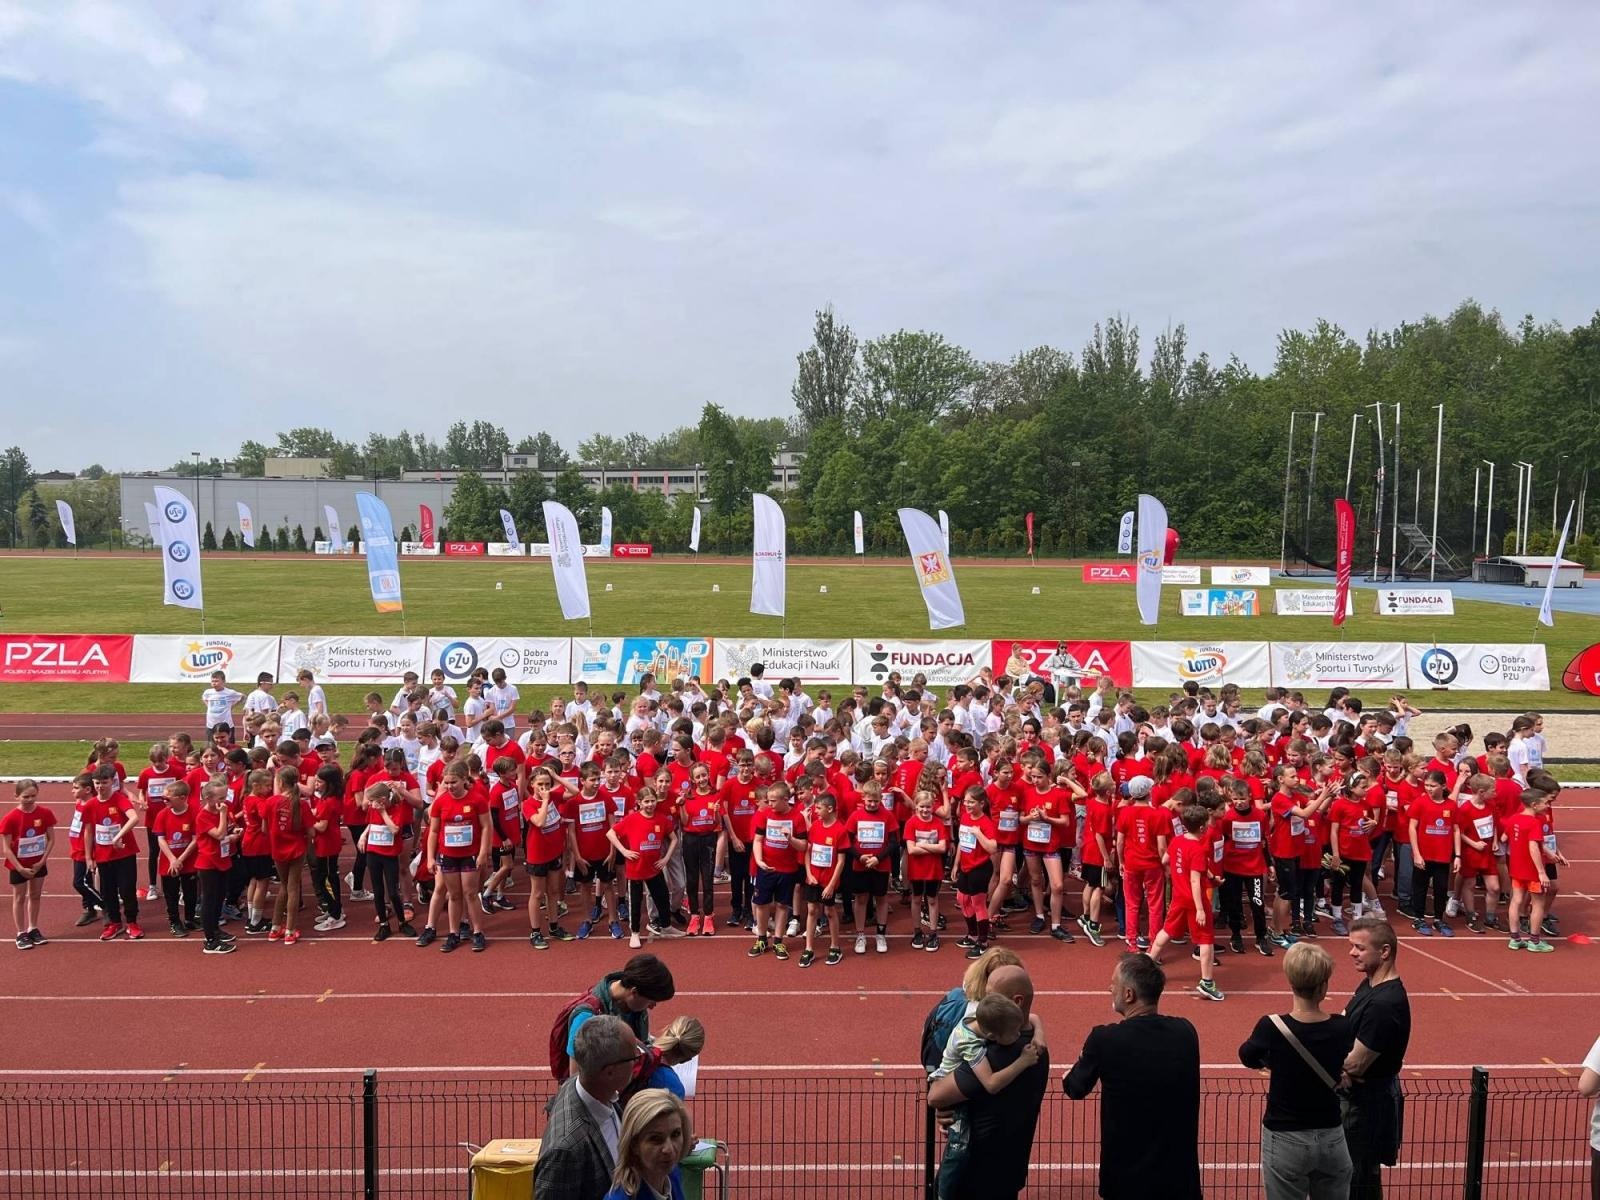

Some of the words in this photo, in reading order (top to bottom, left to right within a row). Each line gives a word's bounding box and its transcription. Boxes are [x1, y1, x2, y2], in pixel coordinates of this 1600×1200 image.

[1091, 568, 1130, 577] PZLA
[5, 642, 110, 666] PZLA
[329, 647, 392, 656] Ministerstwo
[524, 649, 549, 657] Dobra
[763, 647, 828, 657] Ministerstwo
[1316, 652, 1374, 661] Ministerstwo
[192, 652, 223, 667] LOTTO
[328, 658, 360, 669] Sportu
[363, 659, 366, 668] i
[368, 658, 411, 669] Turystyki
[448, 653, 470, 669] PZU
[891, 652, 975, 666] FUNDACJA
[1021, 649, 1110, 671] PZA
[1188, 657, 1217, 672] LOTTO
[1501, 655, 1526, 663] Dobra
[762, 660, 803, 671] Edukacji
[811, 660, 840, 669] Nauki
[1316, 664, 1346, 673] Sportu
[1353, 664, 1394, 674] Turystyki
[1253, 878, 1263, 905] asics
